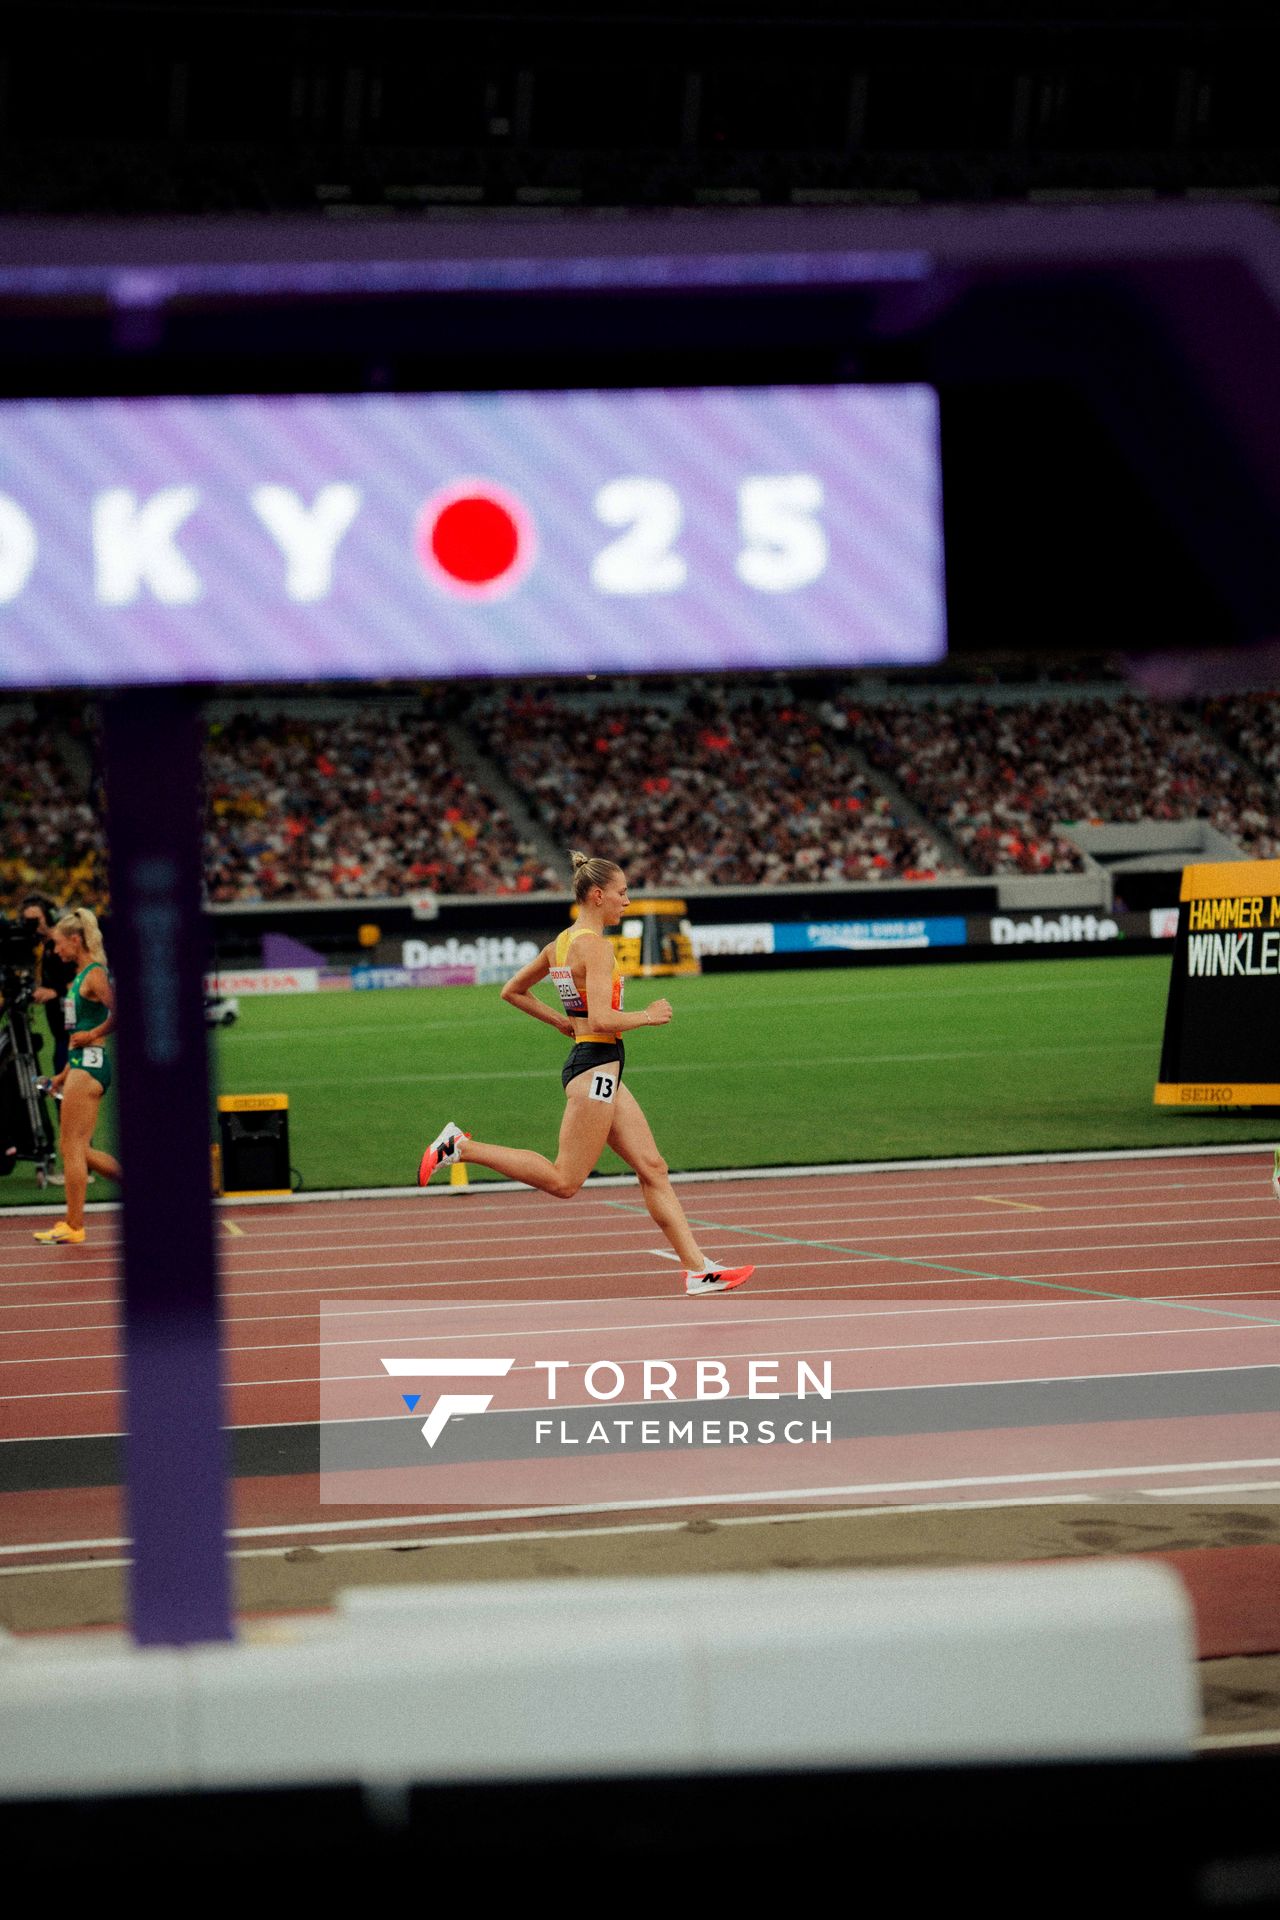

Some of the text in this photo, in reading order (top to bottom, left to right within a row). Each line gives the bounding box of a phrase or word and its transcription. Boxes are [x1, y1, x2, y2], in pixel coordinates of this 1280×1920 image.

[1188, 897, 1264, 931] HAMMER
[1188, 931, 1280, 977] WINKLE
[595, 1076, 613, 1098] 13
[1181, 1087, 1233, 1102] SEIKO
